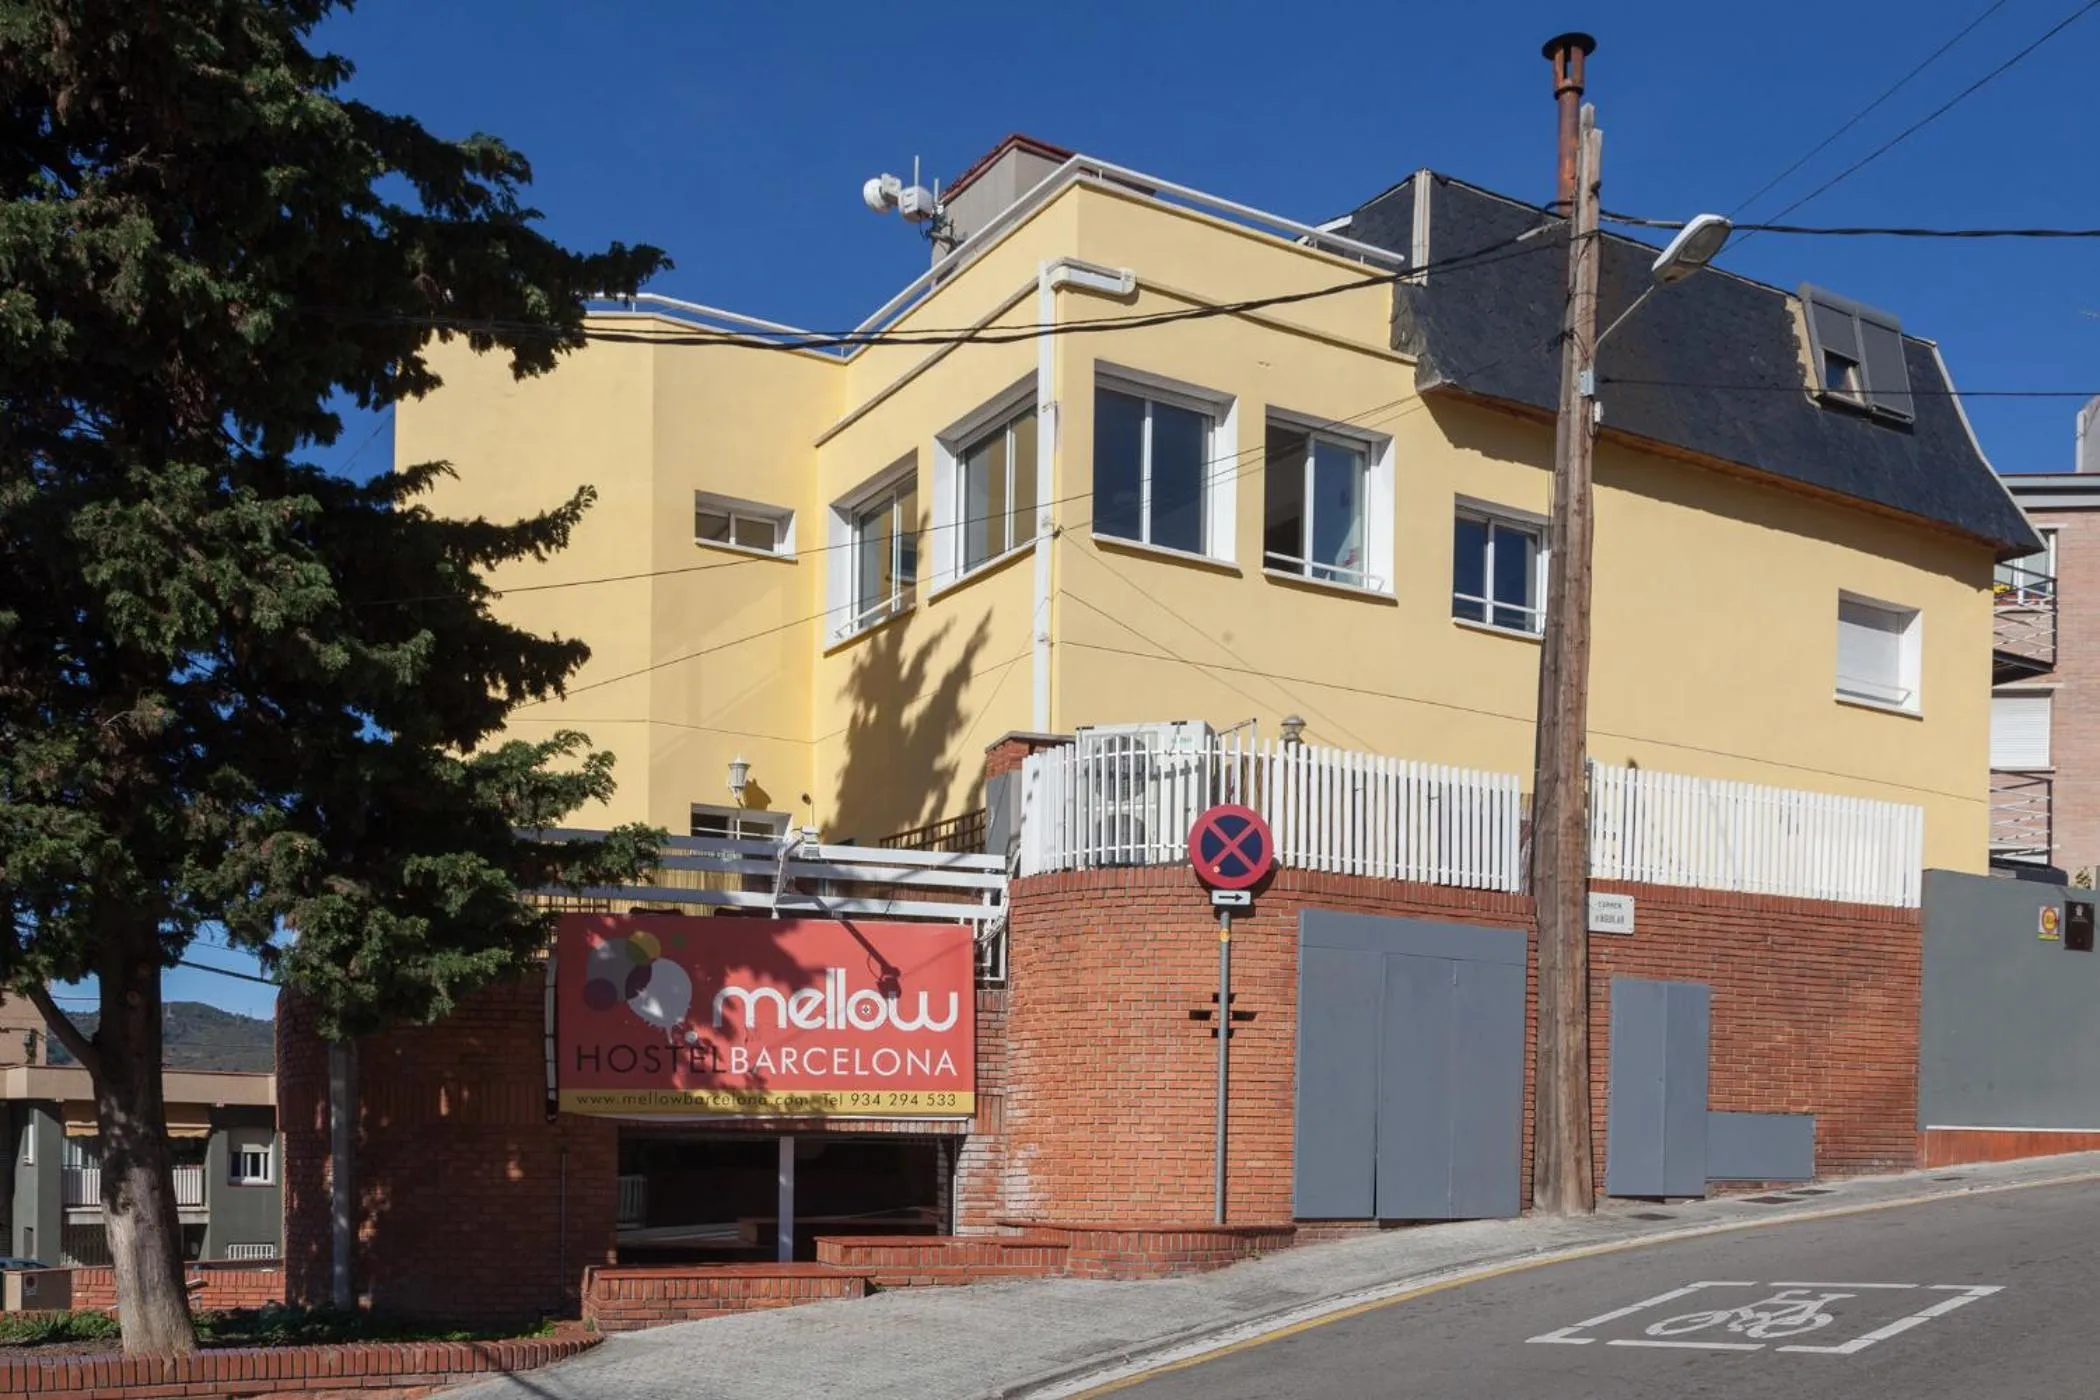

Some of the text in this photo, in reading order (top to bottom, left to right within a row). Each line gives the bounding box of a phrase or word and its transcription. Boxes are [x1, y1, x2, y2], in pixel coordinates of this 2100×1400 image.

[712, 967, 958, 1032] mellow
[822, 1092, 844, 1106] Tel
[851, 1093, 881, 1107] 934
[889, 1093, 918, 1107] 294
[926, 1093, 956, 1107] 533
